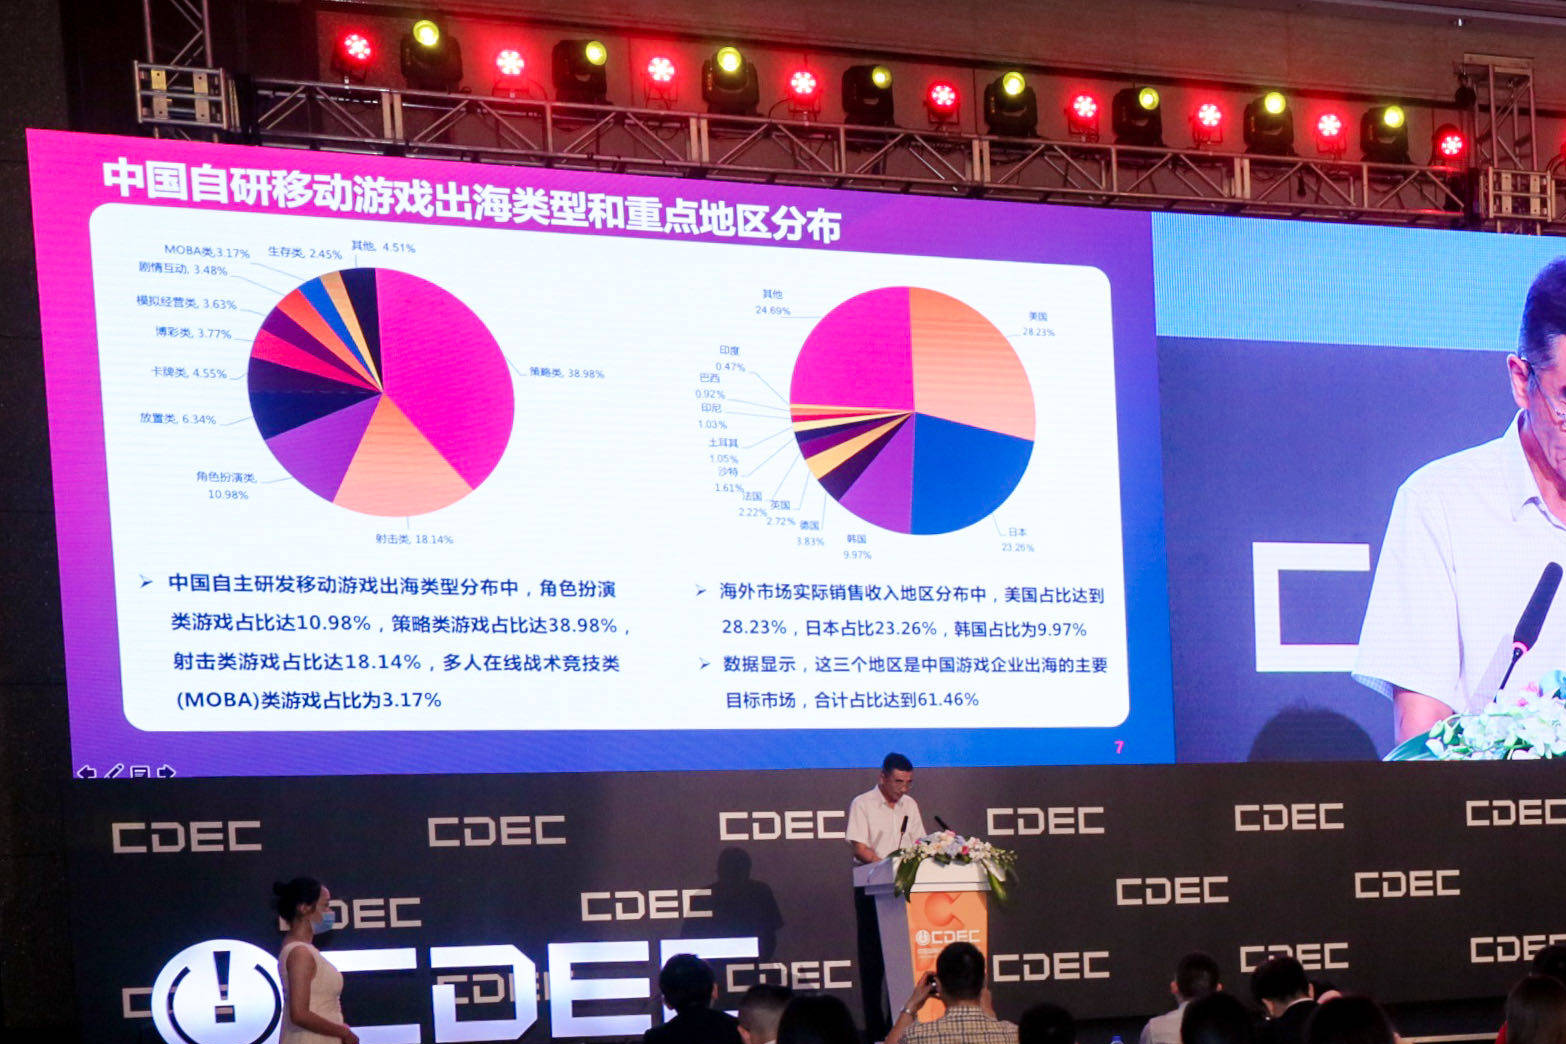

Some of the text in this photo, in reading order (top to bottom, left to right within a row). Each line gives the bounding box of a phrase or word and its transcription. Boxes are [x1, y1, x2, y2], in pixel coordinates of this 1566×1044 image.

[102, 156, 843, 244] 中国自研移动游戏出海类型和重点地区分布
[309, 248, 343, 260] 2.45%
[382, 242, 417, 254] 4.51%
[194, 264, 228, 276] 3.48%
[203, 298, 238, 311] 3.63%
[197, 327, 233, 340] 3.77%
[192, 367, 228, 379] 4.55%
[568, 368, 605, 379] 38.98%
[182, 414, 217, 425] 6.34%
[208, 489, 249, 500] 10.98%
[416, 534, 454, 545] 18.14%
[1113, 738, 1126, 756] 7
[719, 810, 845, 840] CDEC
[987, 807, 1104, 835] CDEC
[1235, 803, 1344, 831] CDEC
[112, 821, 261, 853] CDEC
[428, 816, 566, 846] CDEC
[1117, 877, 1228, 905] CDEC
[1355, 870, 1460, 898] CDEC
[581, 889, 713, 921] CDEC
[931, 929, 980, 944] CDEC
[993, 951, 1110, 982] CDEC
[726, 960, 853, 993] CDEC
